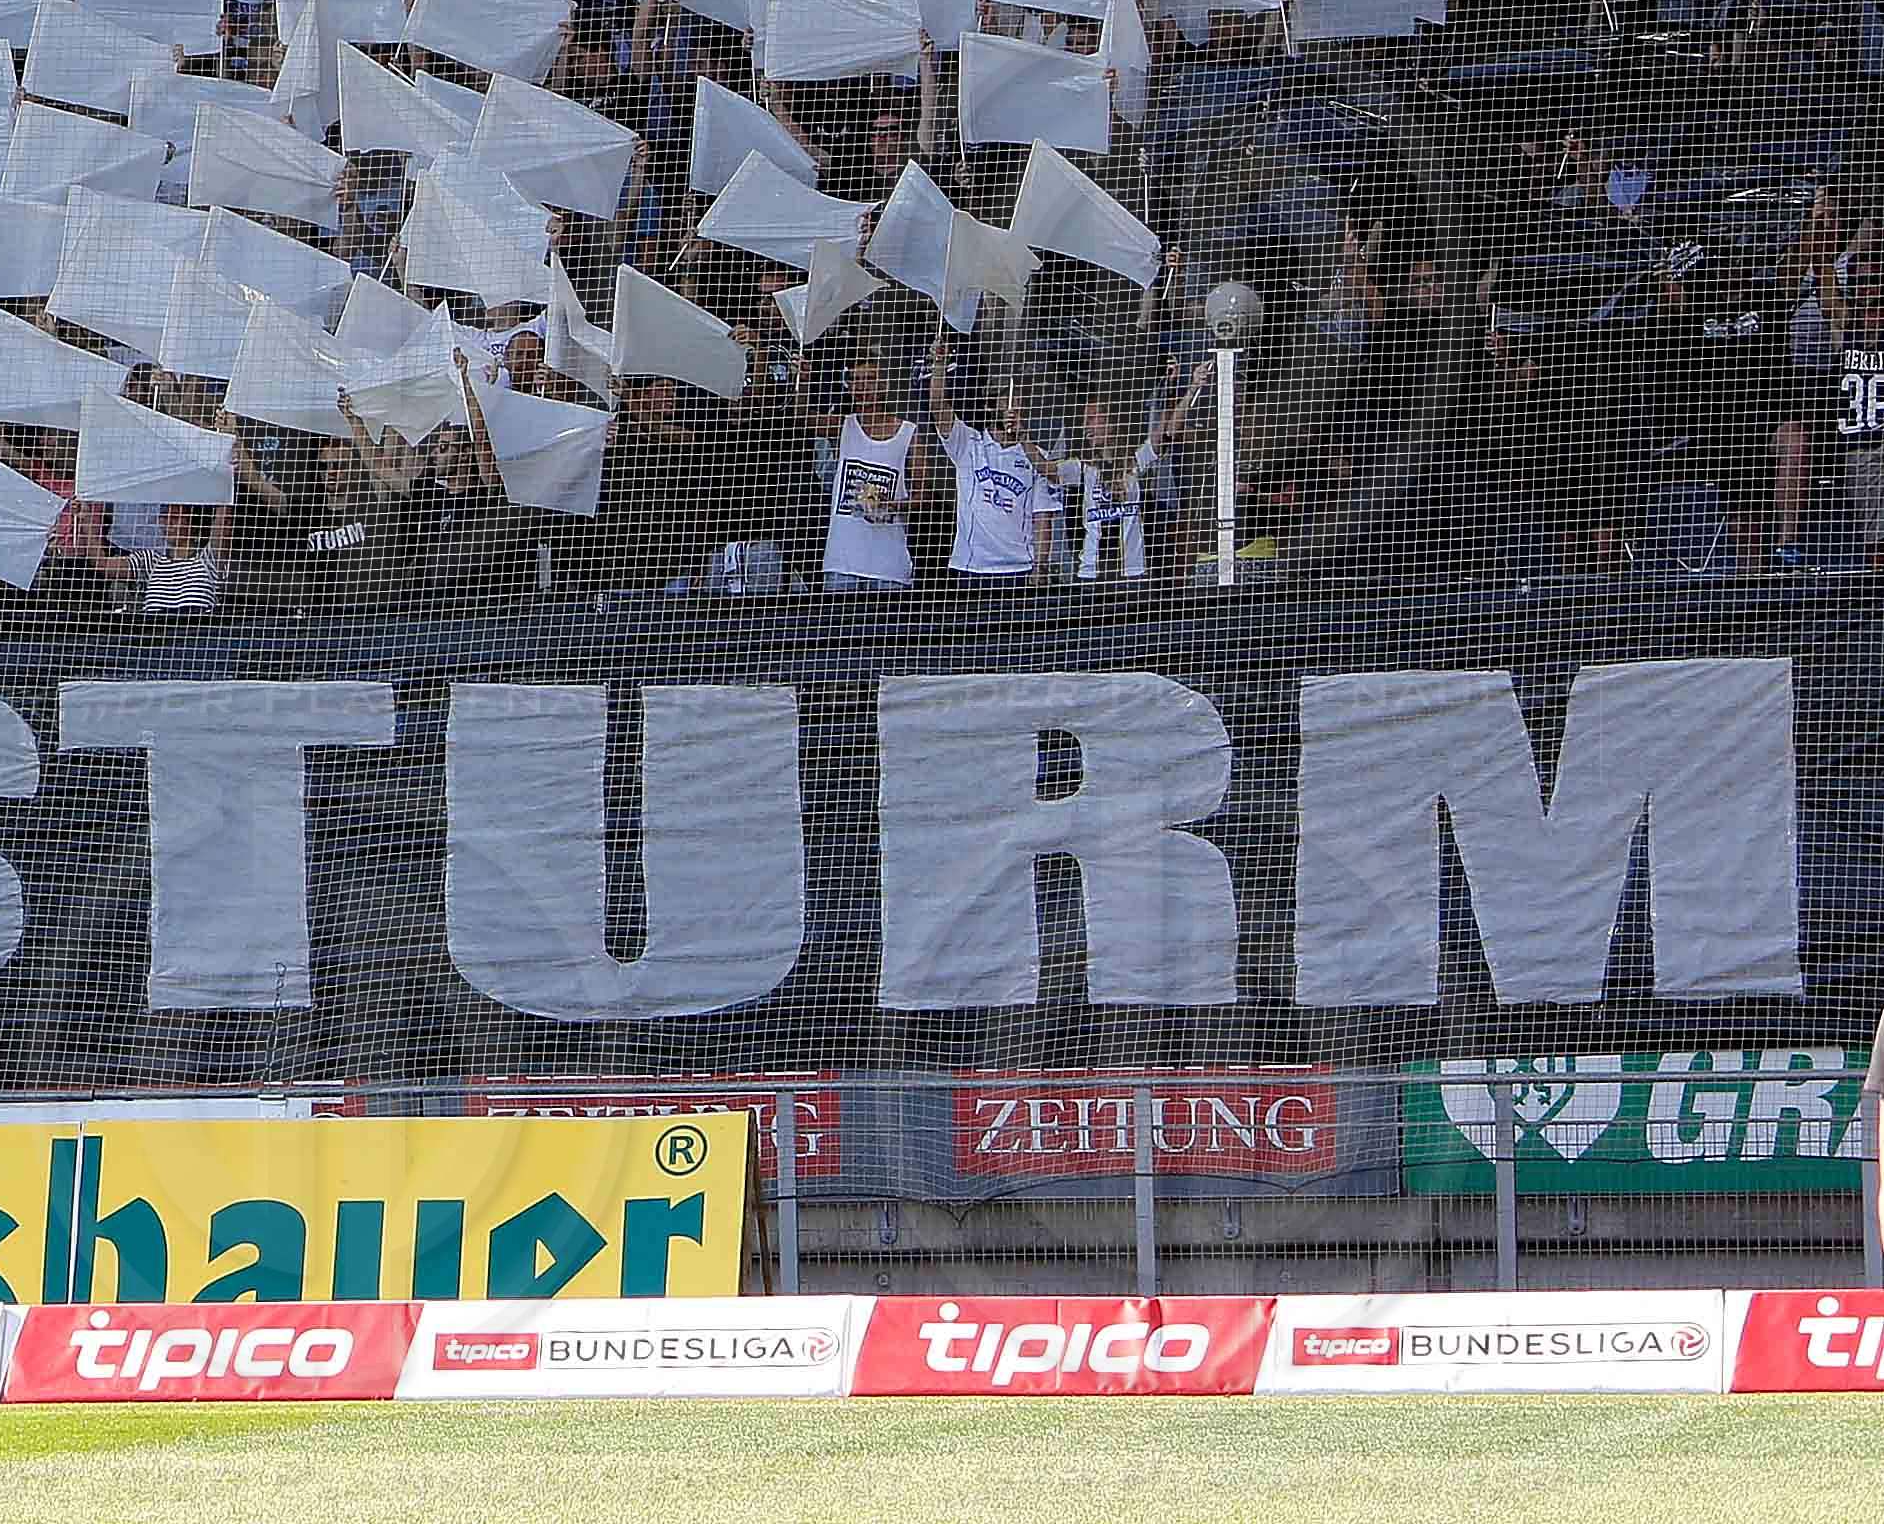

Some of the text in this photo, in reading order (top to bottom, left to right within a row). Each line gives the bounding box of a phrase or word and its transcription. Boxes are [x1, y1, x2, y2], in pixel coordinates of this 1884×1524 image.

[308, 522, 366, 552] STURM
[973, 1092, 1319, 1158] ZEITUNG
[1644, 1050, 1863, 1164] GR
[69, 1308, 354, 1391] tipico
[443, 1336, 797, 1367] tipico BUNDESLIGA
[919, 1300, 1209, 1386] tipico
[1302, 1330, 1663, 1364] tipico BUNDESLIGA
